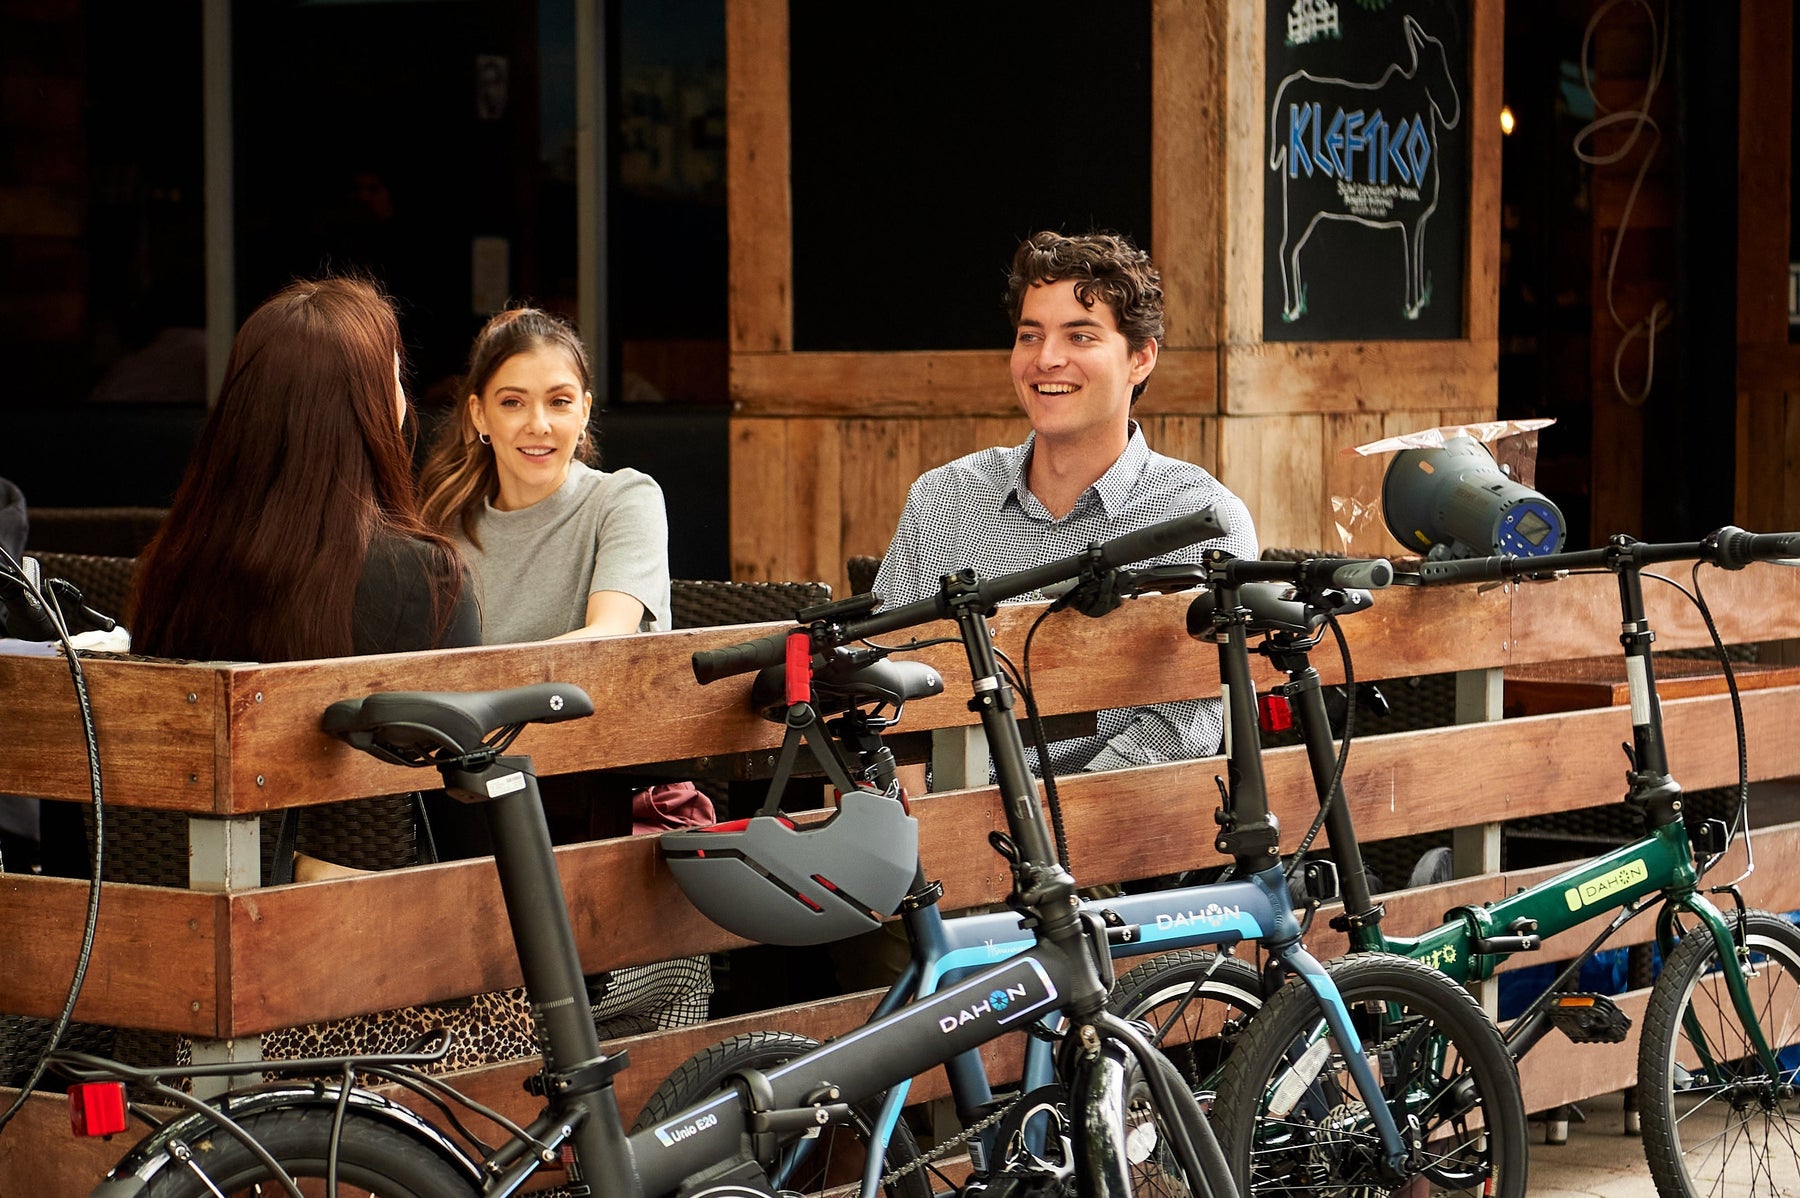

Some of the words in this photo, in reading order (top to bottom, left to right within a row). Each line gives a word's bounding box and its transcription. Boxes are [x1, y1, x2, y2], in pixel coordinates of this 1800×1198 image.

[1586, 867, 1642, 897] DAHON
[1156, 903, 1240, 931] DAHON
[938, 983, 1027, 1034] DAHON
[670, 1125, 697, 1142] Unio
[695, 1113, 718, 1131] E20
